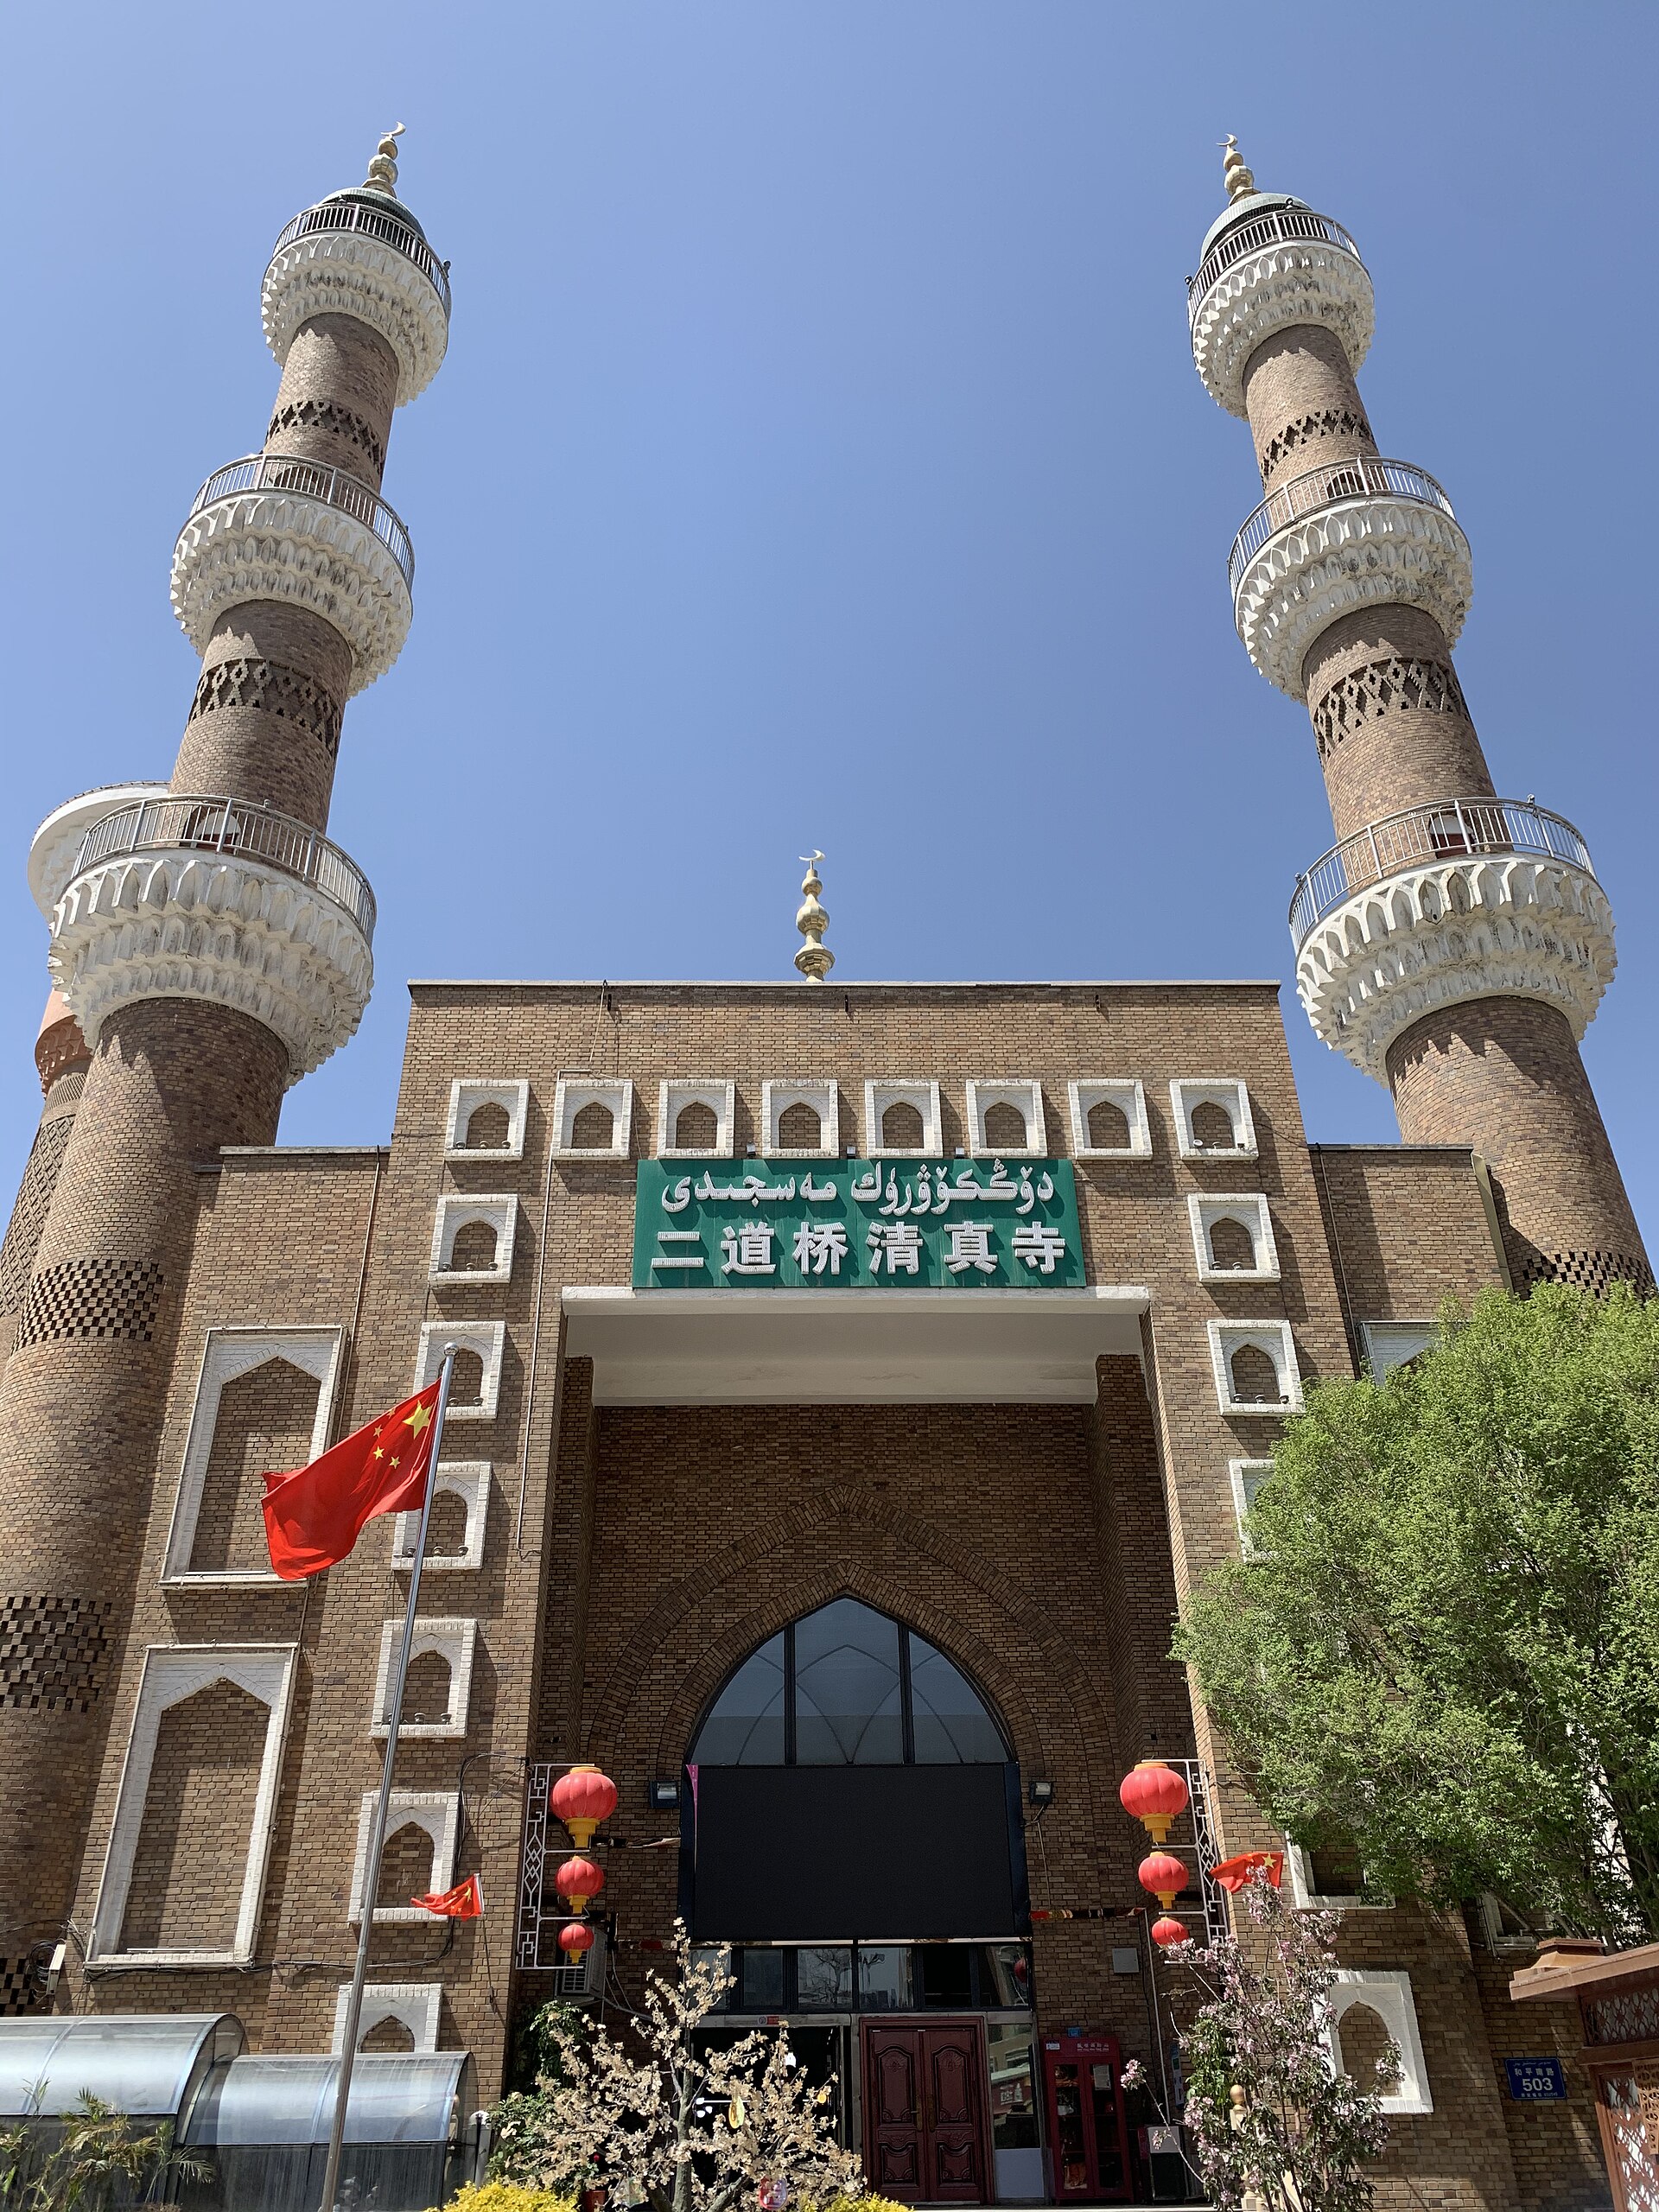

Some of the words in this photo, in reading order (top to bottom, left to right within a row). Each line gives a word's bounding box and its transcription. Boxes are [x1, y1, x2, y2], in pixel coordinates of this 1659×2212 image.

[651, 1220, 1066, 1275] 二道桥清真寺
[1522, 2077, 1554, 2091] 503
